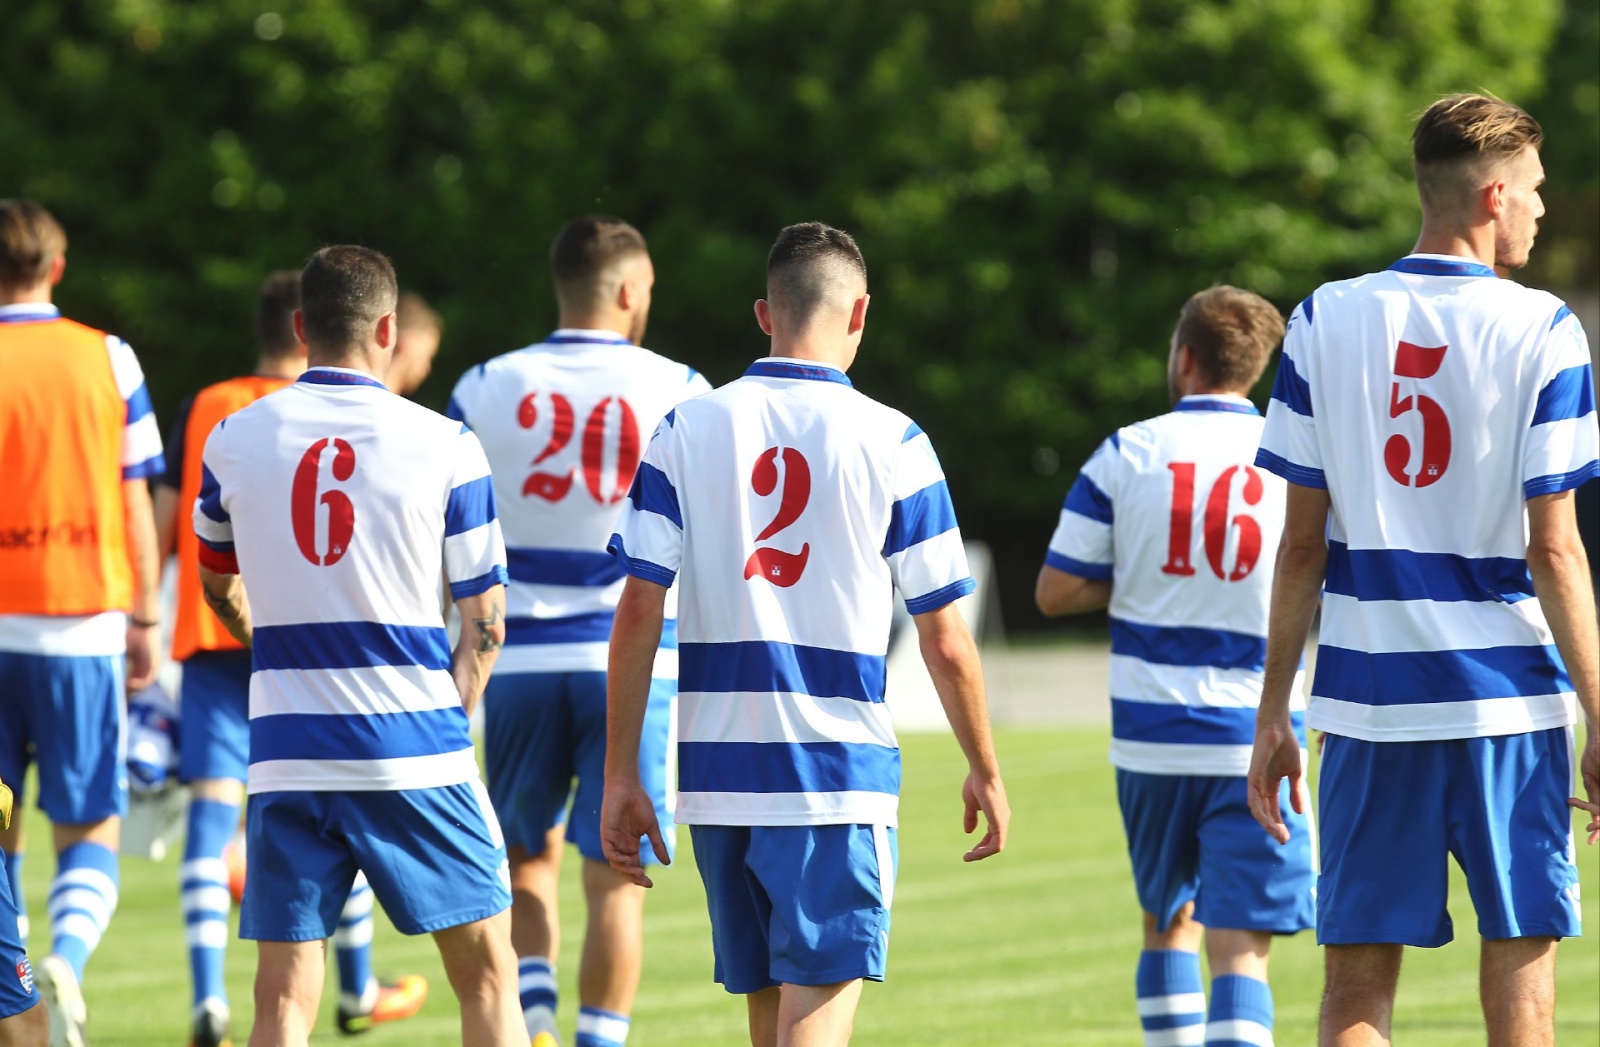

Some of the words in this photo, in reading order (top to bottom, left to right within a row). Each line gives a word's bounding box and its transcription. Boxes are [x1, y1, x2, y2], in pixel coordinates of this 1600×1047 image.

[516, 392, 640, 505] 20
[1384, 340, 1452, 488] 5
[291, 437, 357, 566] 6
[744, 446, 811, 588] 2
[1162, 461, 1263, 582] 16
